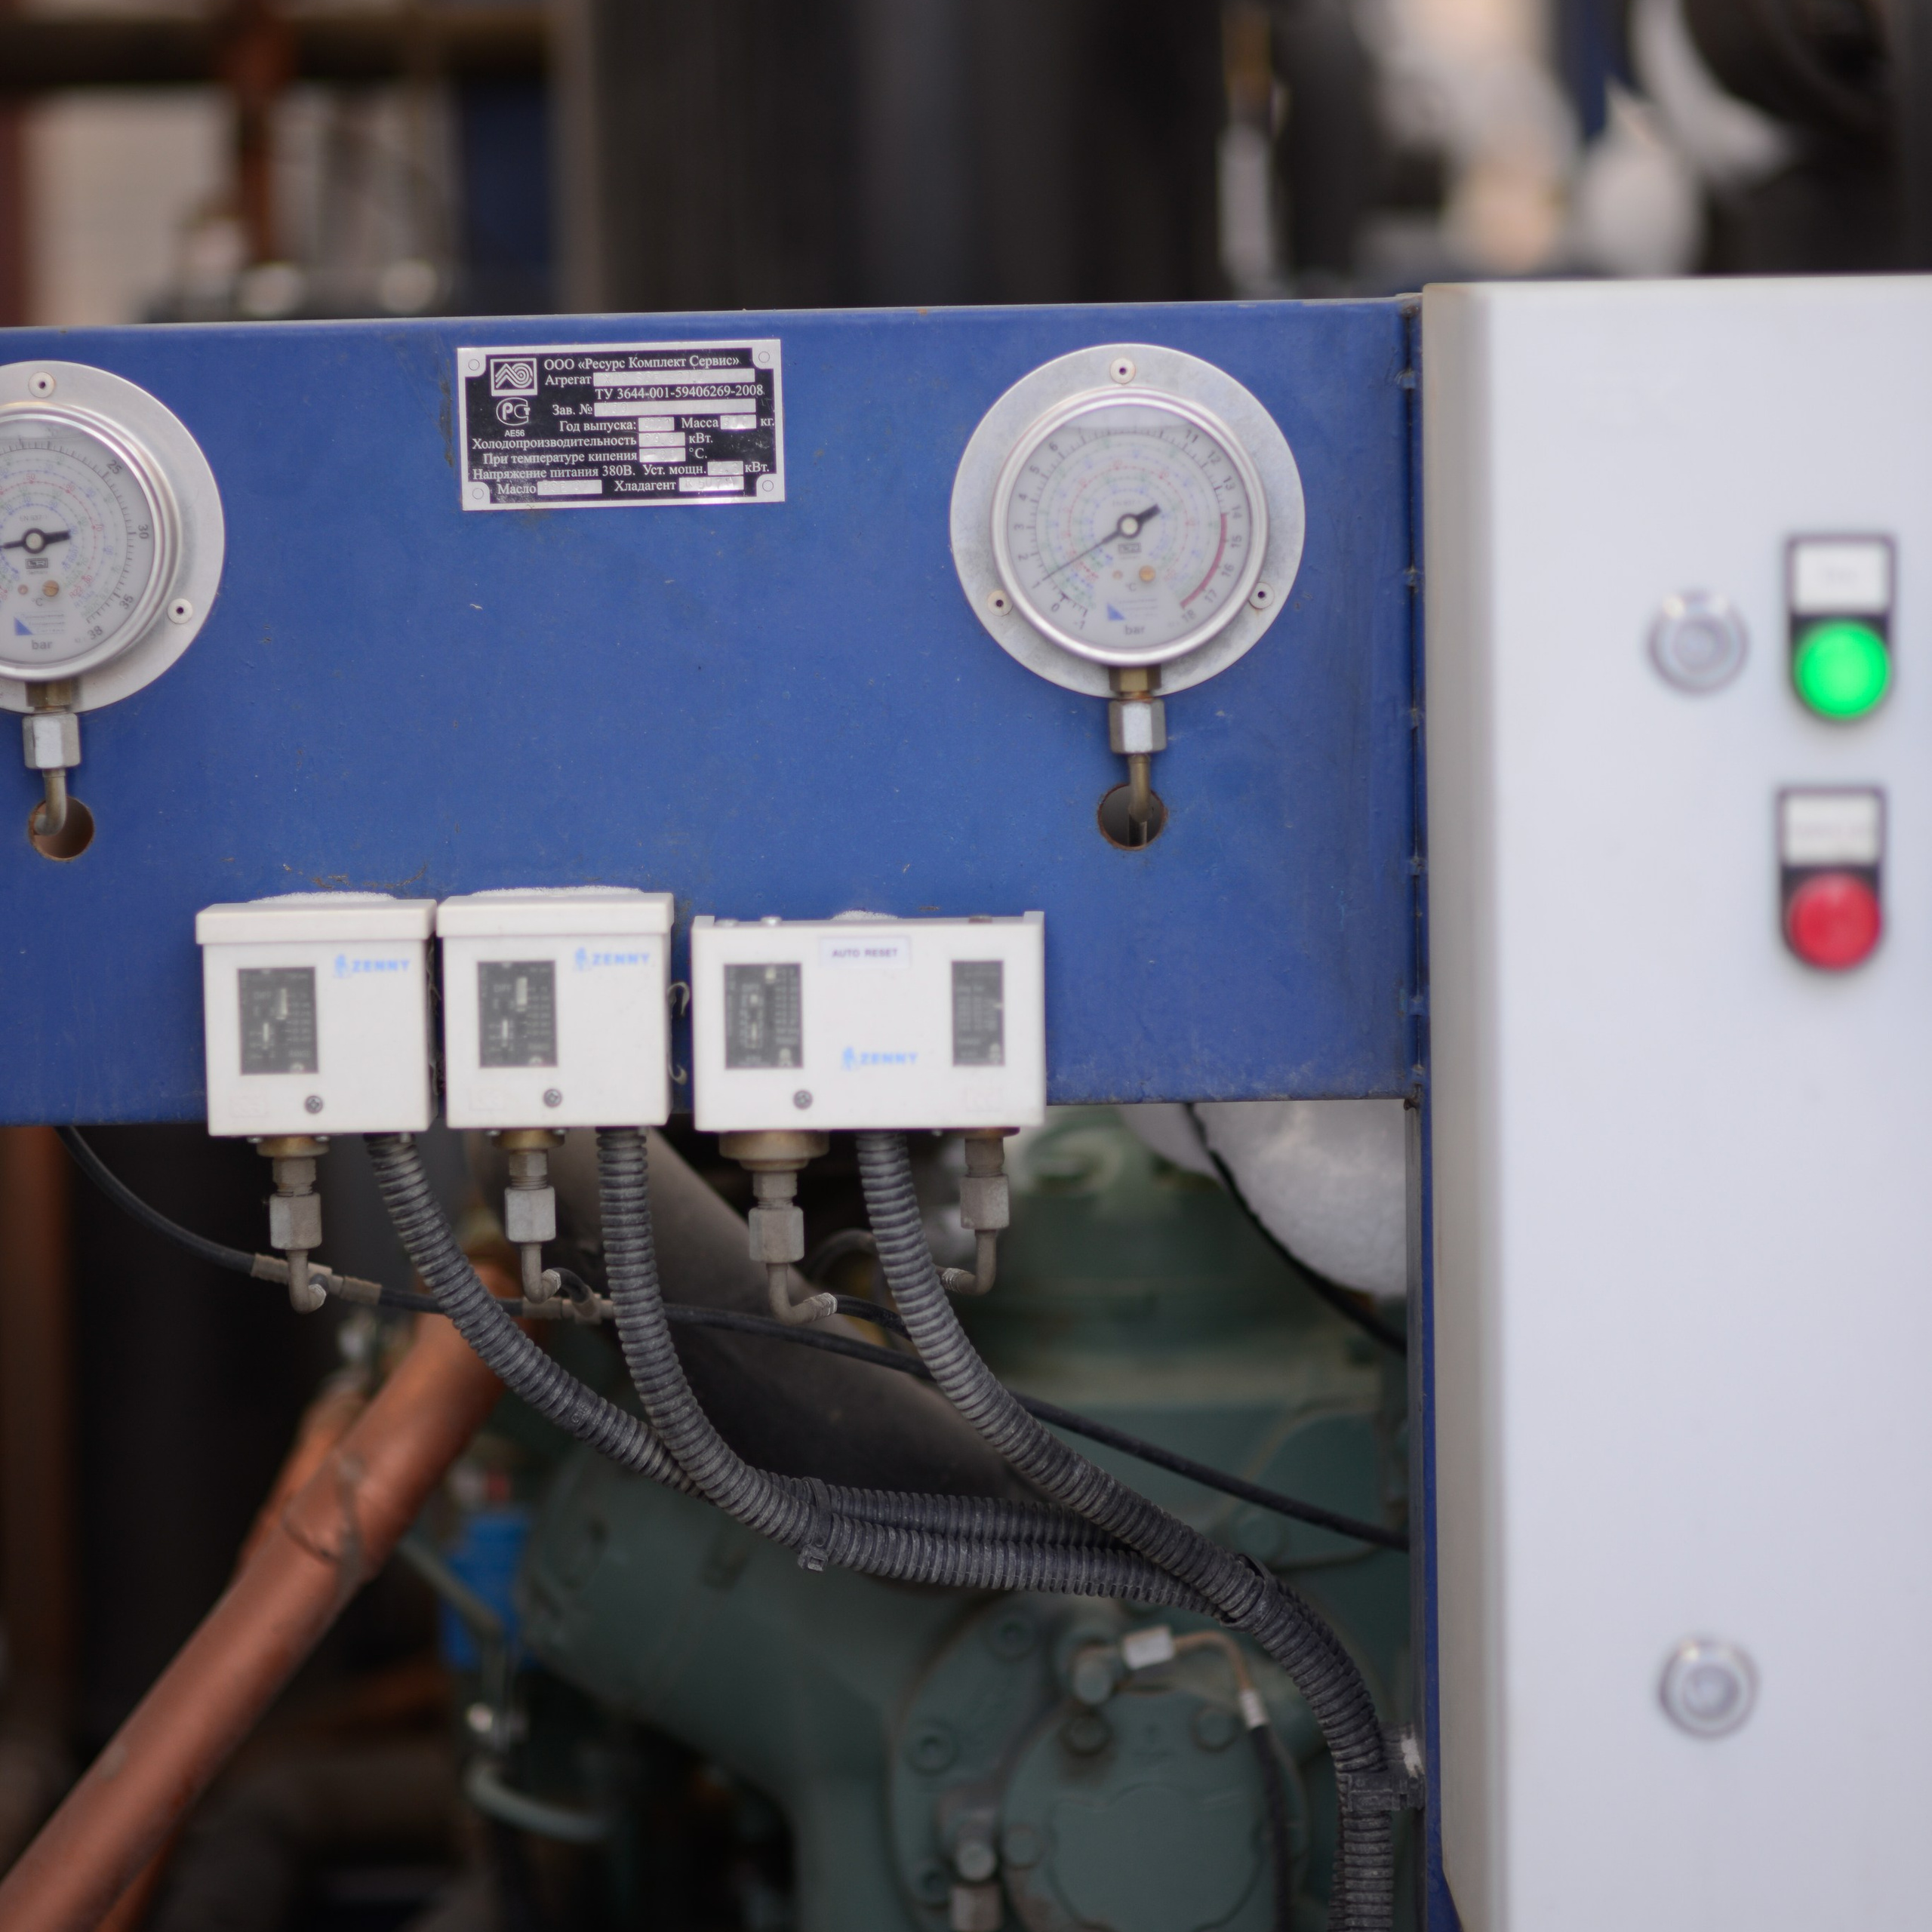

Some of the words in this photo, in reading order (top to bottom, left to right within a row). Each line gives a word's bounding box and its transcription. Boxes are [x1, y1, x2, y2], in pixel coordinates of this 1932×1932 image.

[543, 358, 575, 371] ООО
[578, 358, 626, 372] «Ресурс
[629, 356, 687, 369] Комплект
[689, 355, 740, 369] Сервис»
[544, 374, 592, 388] Агрегат
[595, 388, 614, 400] ТУ
[617, 384, 763, 399] 3644-001-59406269-2008
[552, 404, 576, 416] Зав.
[579, 404, 593, 415] №
[559, 420, 580, 433] Год
[583, 420, 637, 434] выпуска:
[681, 417, 719, 429] Масса
[760, 418, 774, 427] кг.
[472, 435, 637, 451] Холодопроизводительность
[688, 432, 713, 444] кВт.
[1186, 429, 1199, 443] 11
[1048, 441, 1058, 452] 6
[483, 453, 508, 466] При
[511, 453, 585, 466] температуре
[588, 451, 638, 462] кипения
[1208, 449, 1222, 464] 12
[106, 459, 123, 475] 25
[472, 468, 547, 481] Напряжение
[550, 467, 598, 478] питания
[602, 465, 635, 477] 380В.
[642, 464, 666, 475] Уст.
[669, 465, 706, 475] мощн.
[745, 461, 769, 472] кВт.
[1029, 464, 1040, 475] 5
[497, 483, 537, 495] Масло
[614, 480, 676, 492] Хладагент
[1223, 475, 1236, 491] 13
[1018, 493, 1028, 501] 4
[138, 524, 149, 540] 30
[1230, 534, 1242, 549] 15
[1221, 563, 1235, 577] 16
[118, 593, 134, 610] 35
[1204, 589, 1217, 603] 17
[1051, 603, 1060, 612] 0
[1181, 609, 1197, 623] 18
[87, 625, 103, 640] 38
[1124, 625, 1146, 635] bar
[31, 639, 53, 650] bar
[592, 952, 650, 966] ZENNY
[832, 948, 860, 958] AUTO
[864, 948, 898, 958] RESET
[352, 958, 410, 973] ZENNY
[860, 1051, 918, 1066] ZENNY
